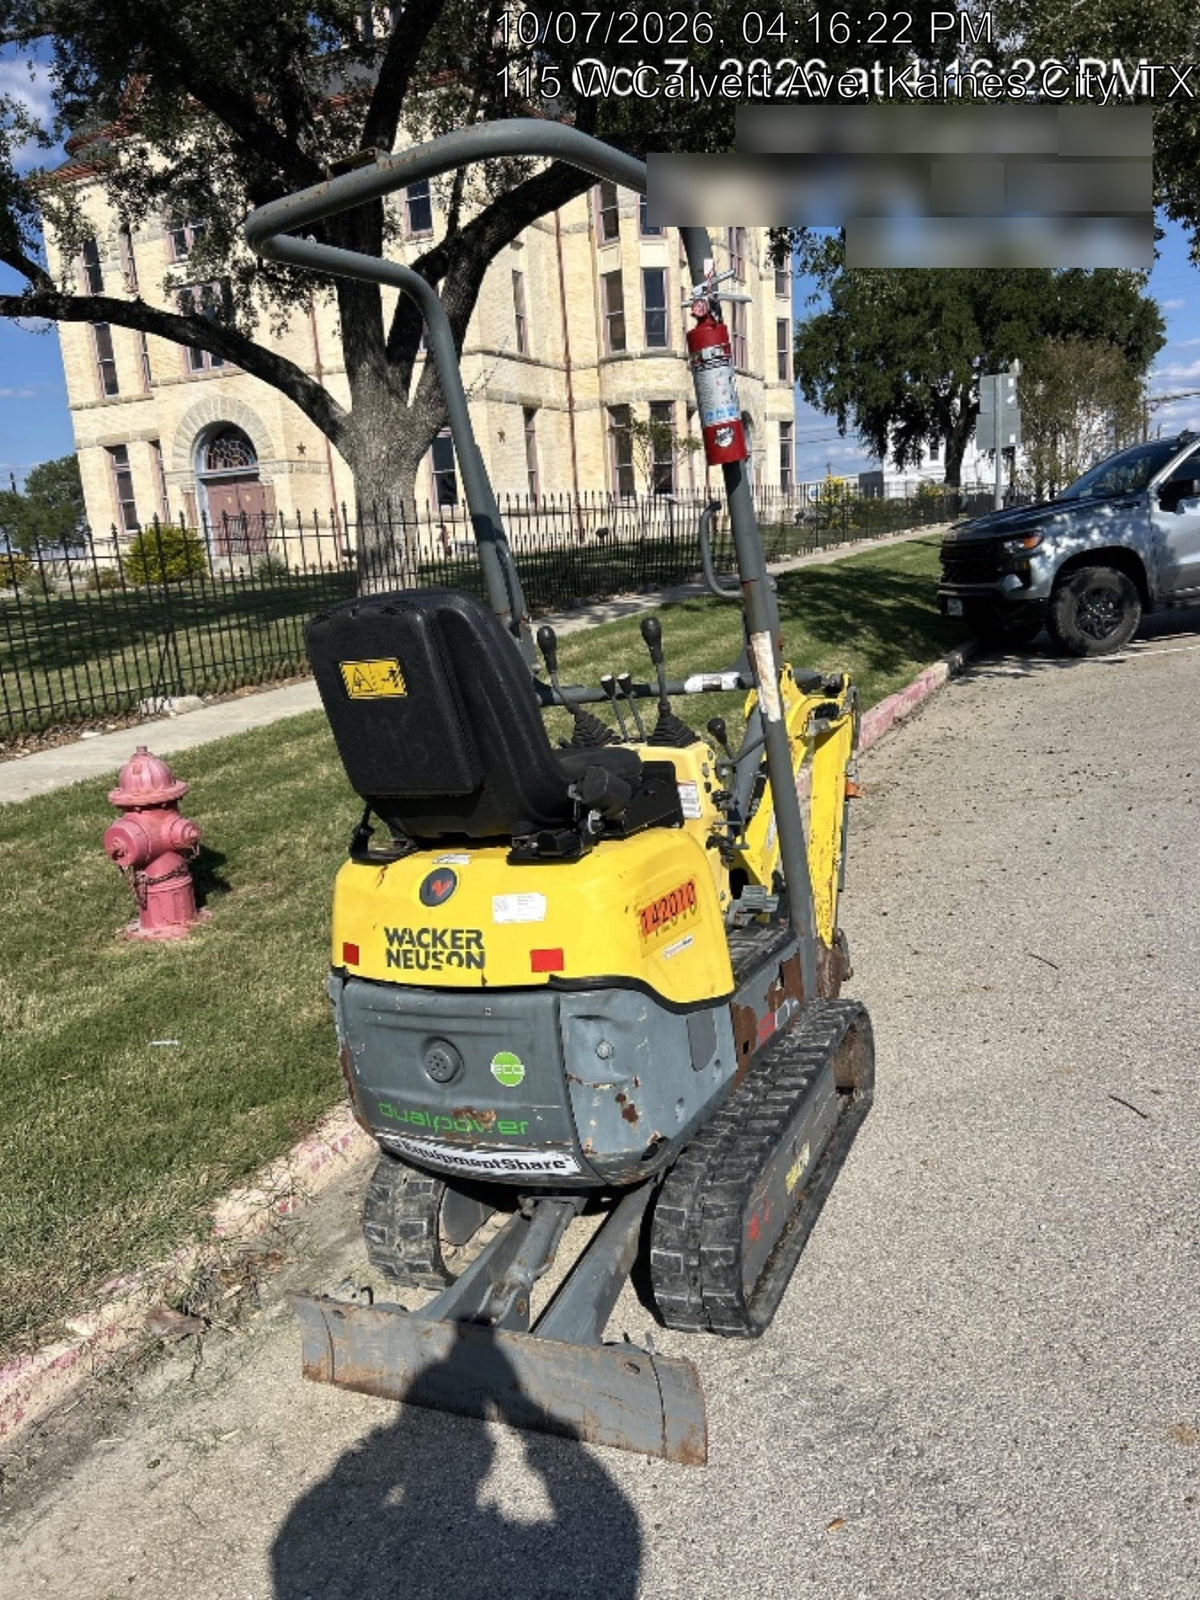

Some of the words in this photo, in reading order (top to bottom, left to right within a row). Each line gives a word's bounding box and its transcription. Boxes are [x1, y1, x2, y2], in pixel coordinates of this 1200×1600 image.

[383, 926, 484, 950] WACKER
[386, 949, 485, 970] NEUSON
[495, 1063, 525, 1075] ECO
